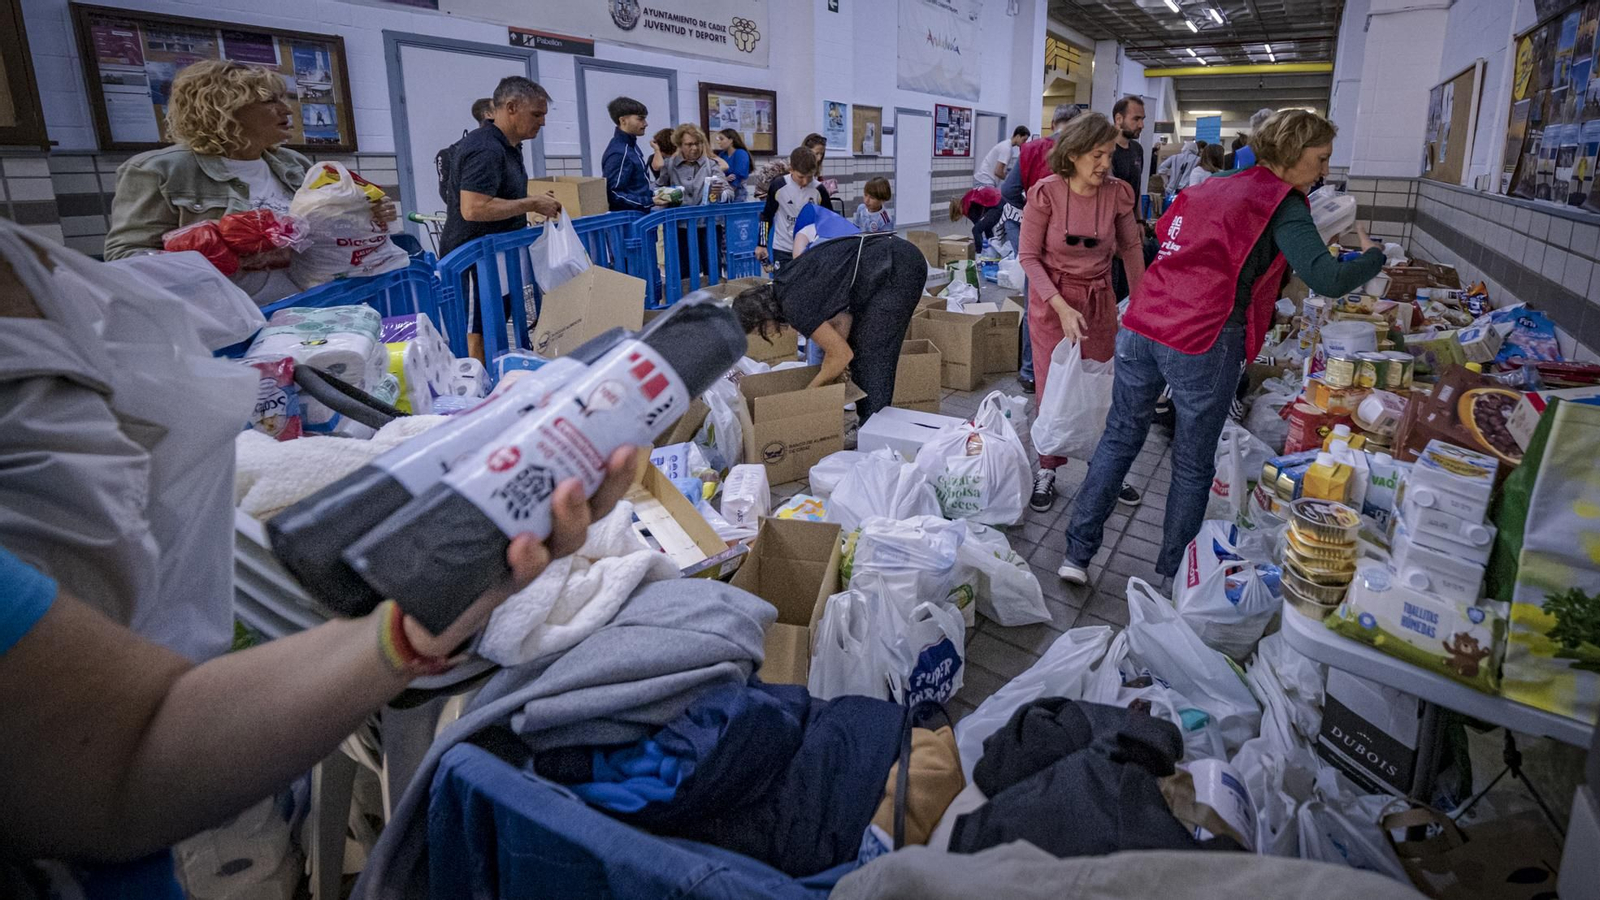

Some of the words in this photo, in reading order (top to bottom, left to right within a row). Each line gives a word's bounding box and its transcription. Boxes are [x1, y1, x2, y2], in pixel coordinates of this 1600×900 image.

[643, 7, 698, 27] AYUNTAMIENTO
[699, 19, 707, 28] DE
[708, 22, 726, 32] CADIZ
[643, 19, 686, 35] JUVENTUD
[689, 28, 695, 36] Y
[696, 30, 727, 44] DEPORTE
[536, 37, 562, 46] Pabellón
[1330, 725, 1398, 776] DUBOIS
